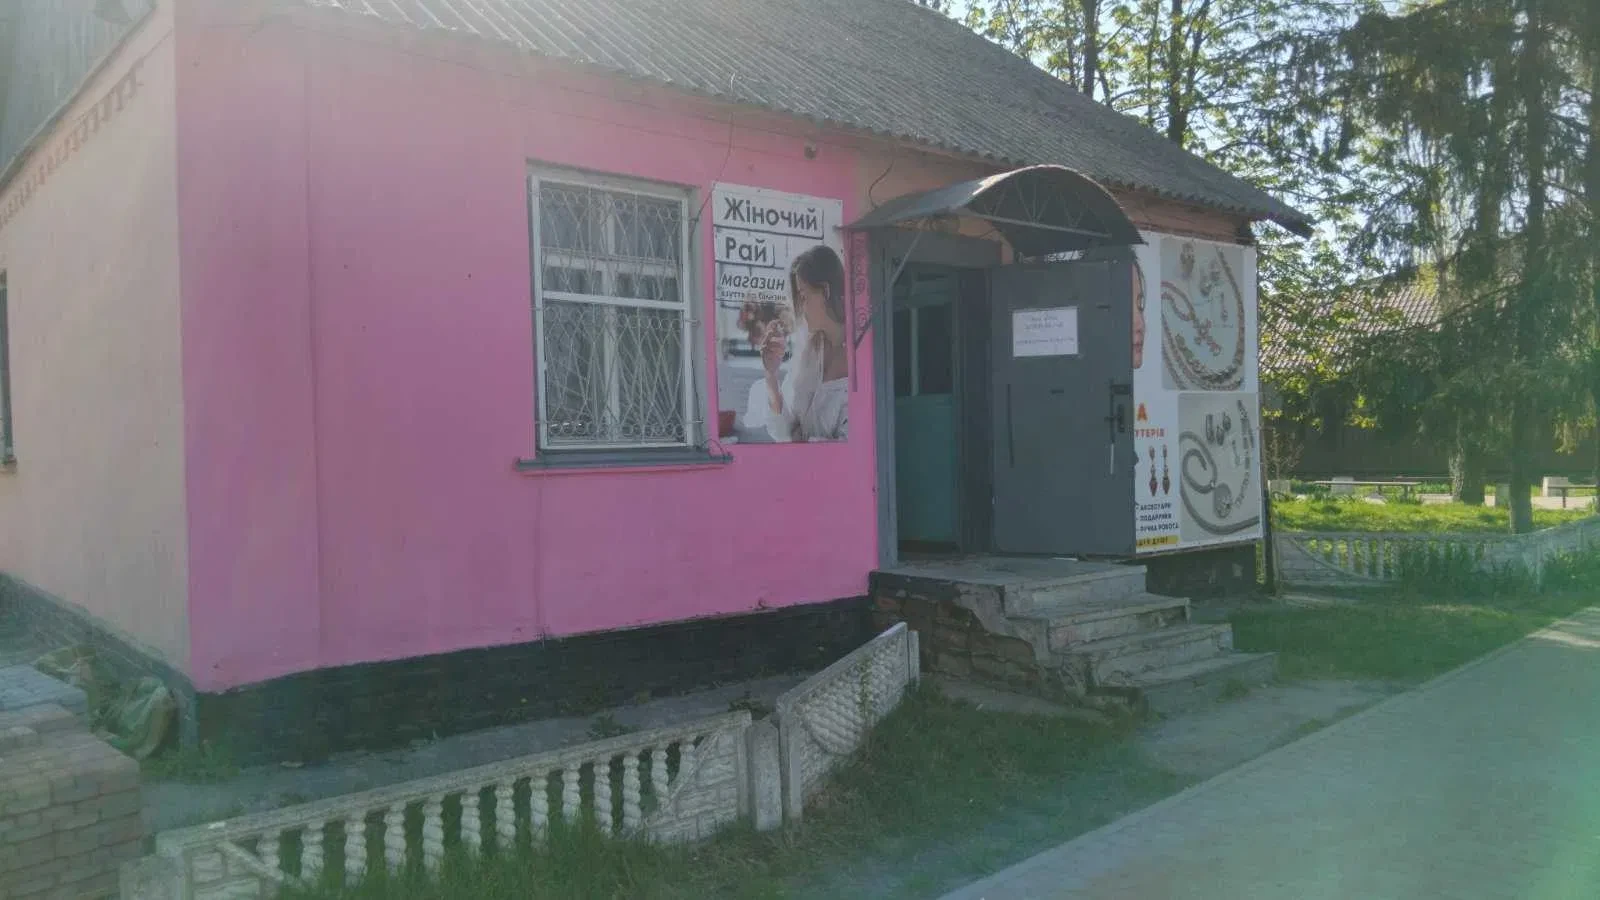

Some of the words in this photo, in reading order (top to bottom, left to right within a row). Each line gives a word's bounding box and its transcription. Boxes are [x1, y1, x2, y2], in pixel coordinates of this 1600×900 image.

[724, 197, 818, 231] Жіночий
[725, 236, 767, 262] Рай
[721, 274, 785, 291] магазин
